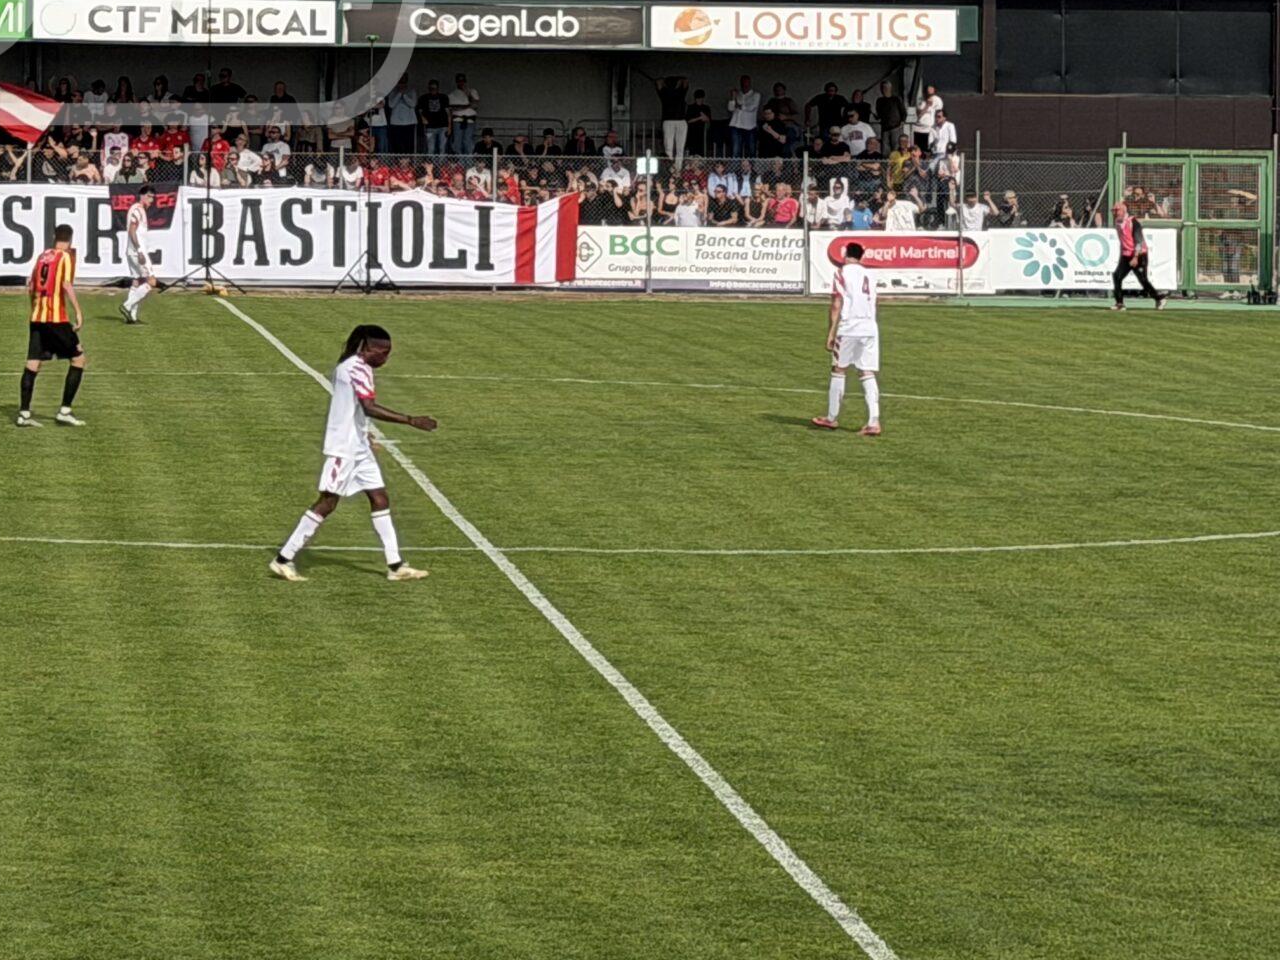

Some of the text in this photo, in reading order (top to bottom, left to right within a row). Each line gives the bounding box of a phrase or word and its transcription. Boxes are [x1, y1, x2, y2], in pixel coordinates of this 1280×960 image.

[88, 4, 327, 37] CTF MEDICAL
[734, 11, 932, 41] LOGISTICS
[187, 197, 495, 271] BASTIOLI
[695, 233, 806, 248] Banca Centro
[609, 234, 680, 256] BCC
[694, 249, 802, 261] Toscana Umbria
[900, 245, 966, 259] Martineli
[41, 264, 50, 285] 9
[646, 264, 688, 273] ancario
